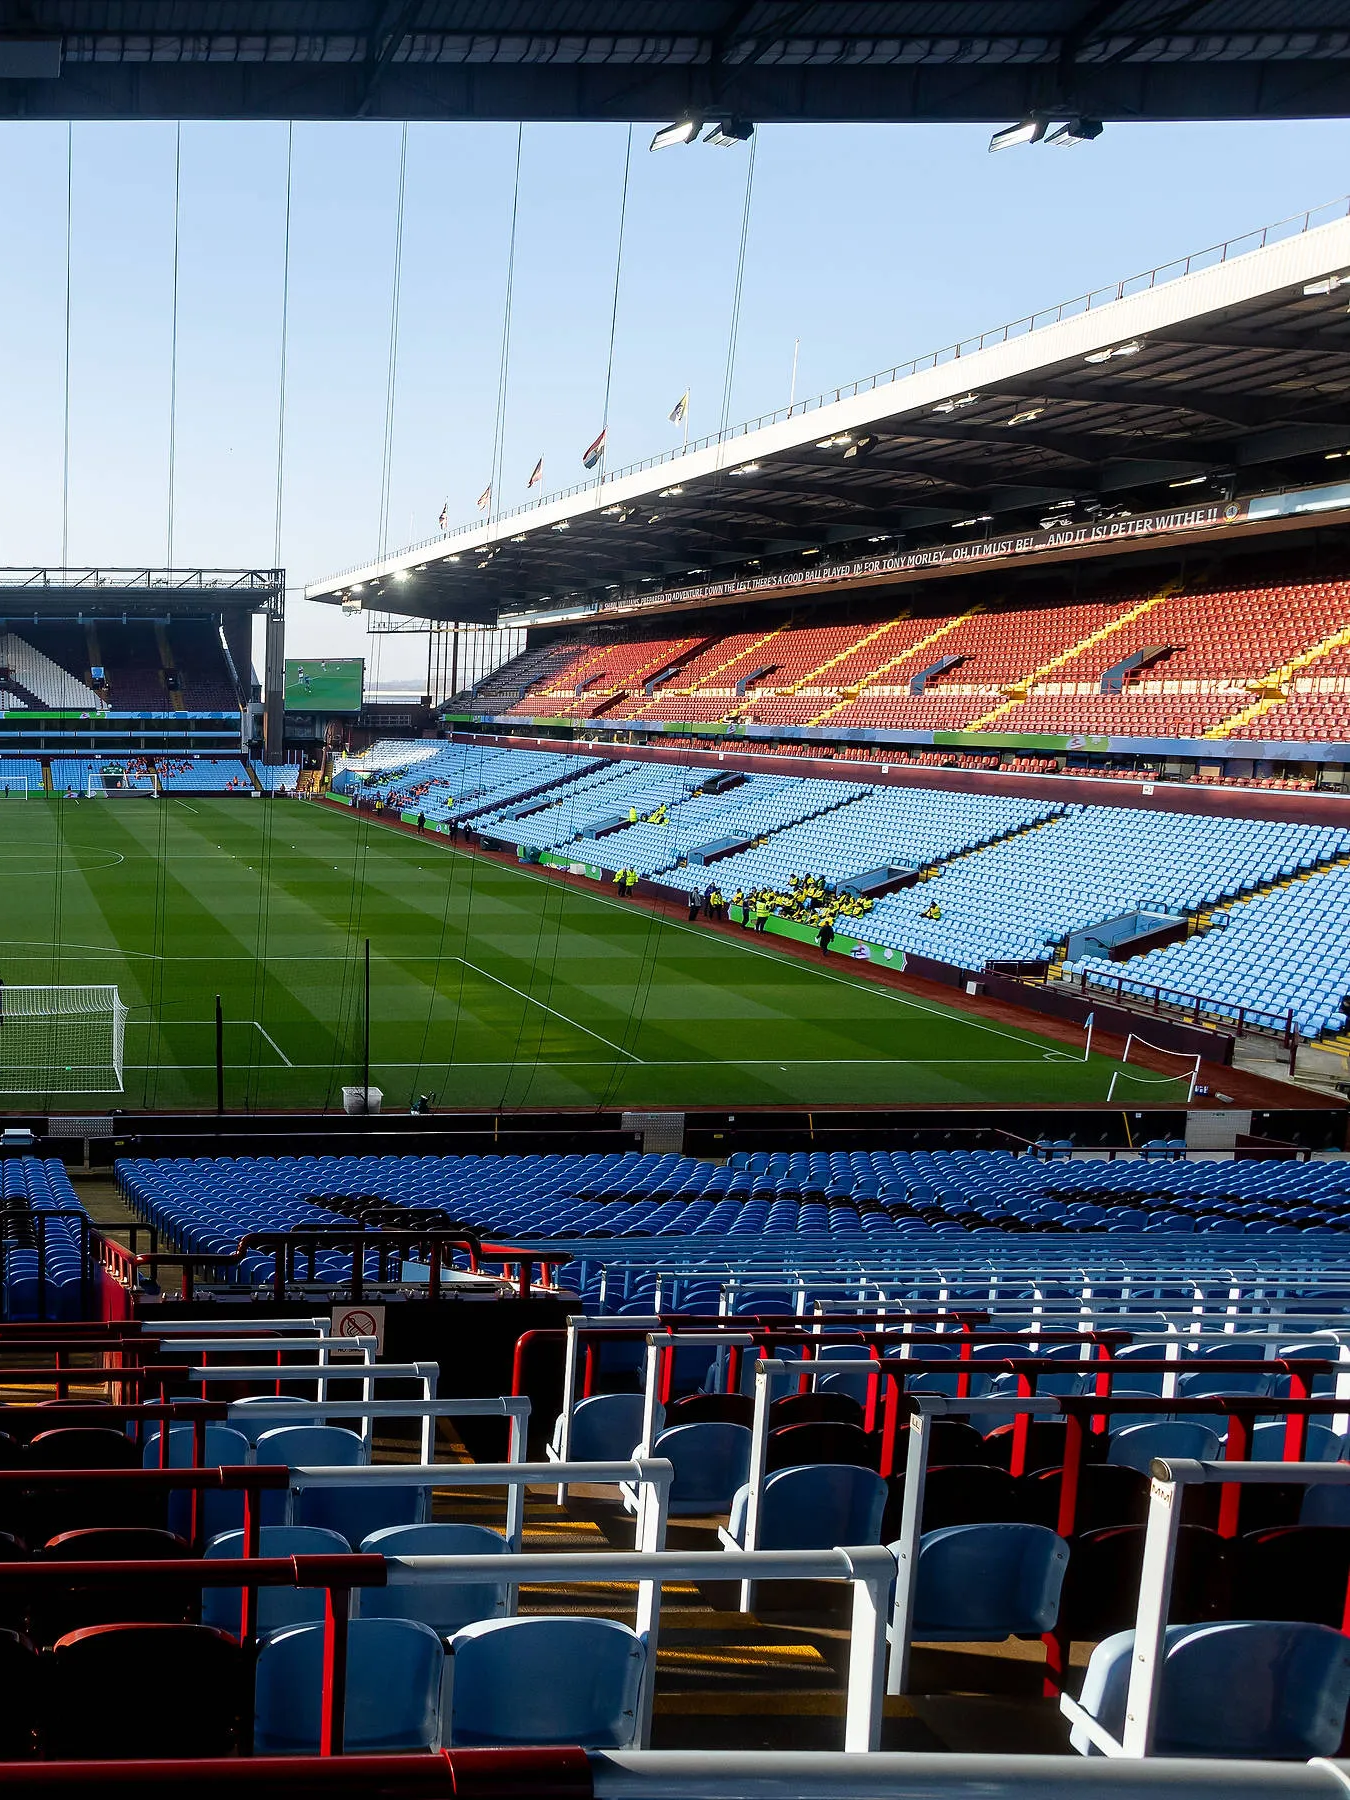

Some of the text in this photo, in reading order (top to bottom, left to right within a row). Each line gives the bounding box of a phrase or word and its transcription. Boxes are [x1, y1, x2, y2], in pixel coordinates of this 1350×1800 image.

[640, 595, 664, 605] PREPARED
[665, 593, 672, 602] TO
[672, 588, 703, 601] ADVENTURE
[723, 582, 735, 593] THE
[752, 576, 777, 588] THERE'S
[783, 572, 803, 584] GOOD
[805, 569, 821, 580] BALL
[823, 565, 850, 578] PLAYED
[853, 563, 863, 574] IN
[864, 561, 880, 572] FOR
[882, 557, 907, 569] TONY
[983, 540, 1013, 555] MUST
[1076, 529, 1087, 542] IT
[1090, 526, 1107, 540] IS!
[1109, 518, 1153, 536] PETER
[1155, 510, 1205, 530] WITHE
